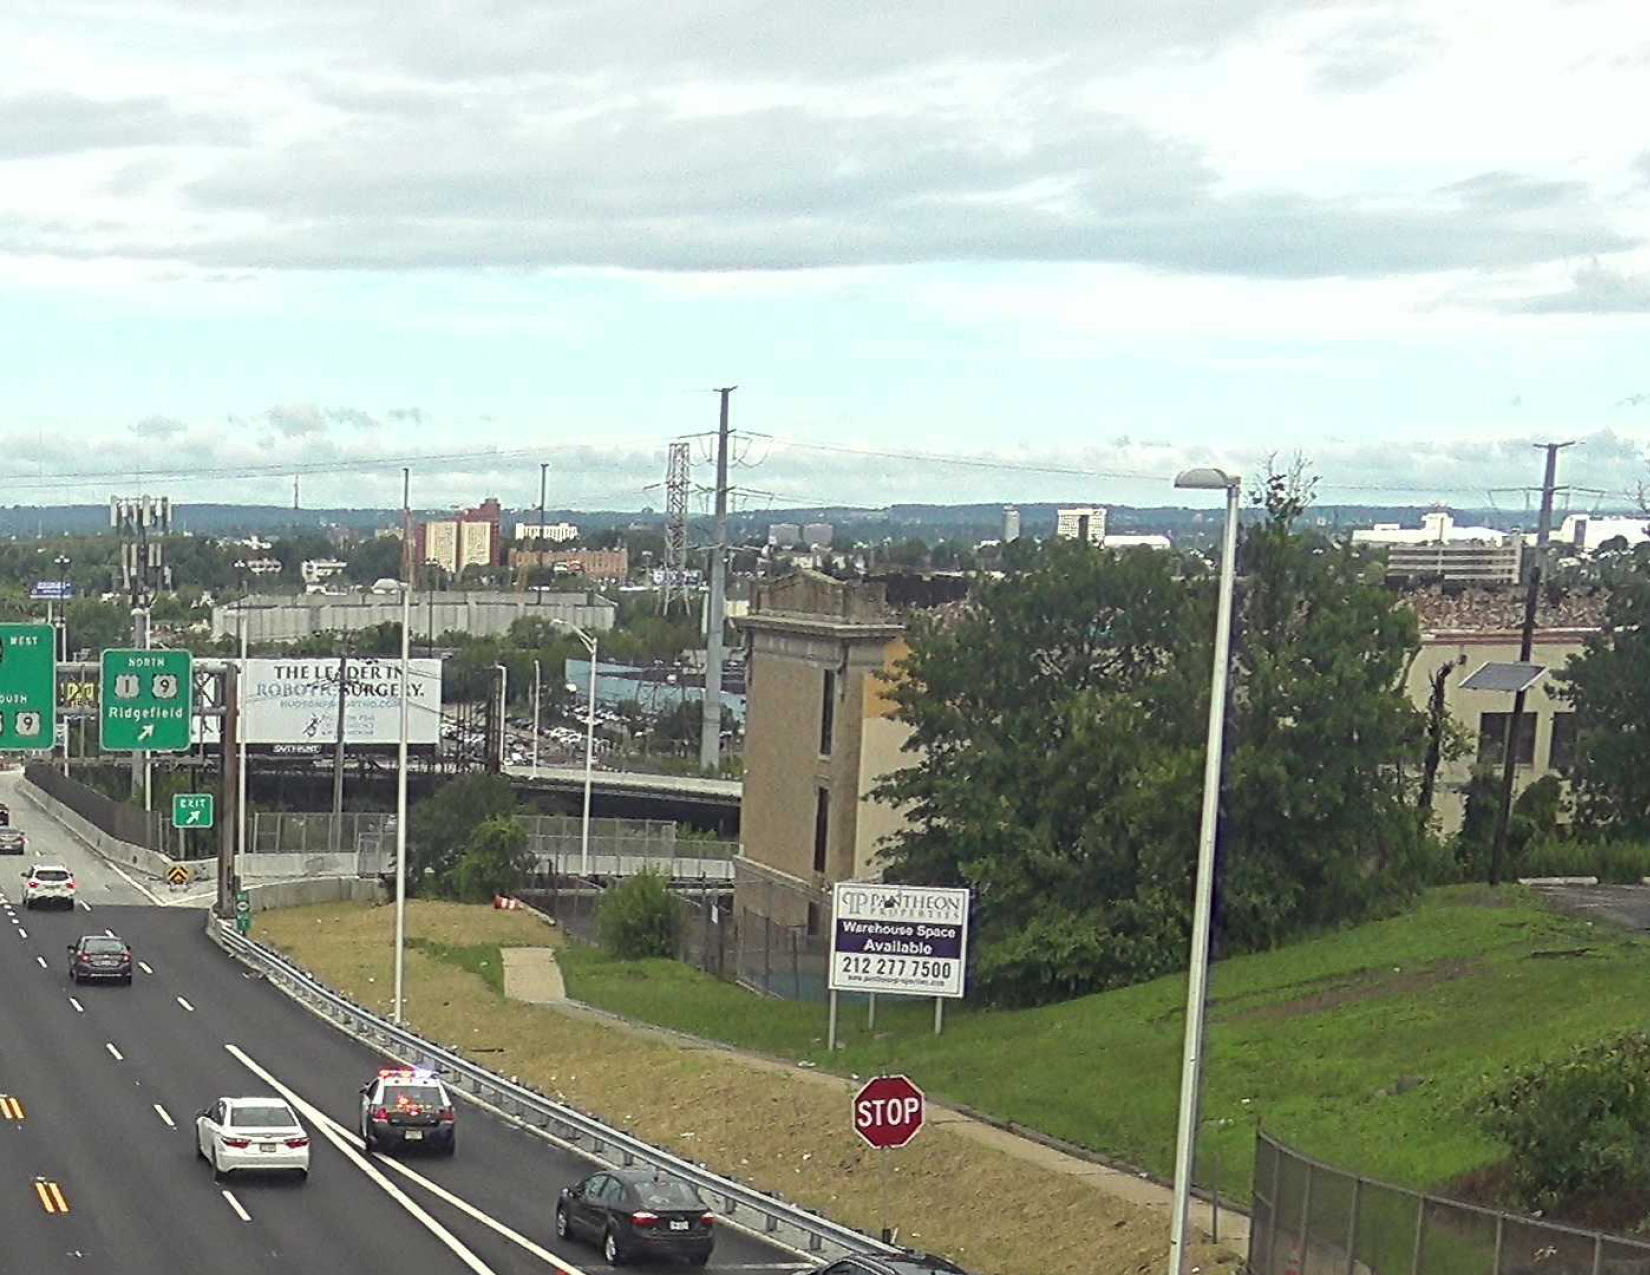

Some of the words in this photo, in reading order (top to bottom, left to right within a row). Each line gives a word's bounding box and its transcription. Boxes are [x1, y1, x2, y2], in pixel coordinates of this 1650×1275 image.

[10, 636, 38, 646] WEST
[128, 658, 165, 667] NORTH
[274, 666, 309, 680] THE
[160, 679, 171, 693] 9
[109, 706, 184, 722] Ridgefield
[23, 717, 34, 731] 9
[180, 799, 206, 808] EXIT
[843, 921, 914, 937] Warehouse
[916, 925, 956, 939] Space
[863, 939, 934, 955] Available
[842, 956, 870, 974] 212
[877, 958, 906, 977] 277
[912, 960, 952, 979] 7500
[857, 1097, 920, 1127] STOP
